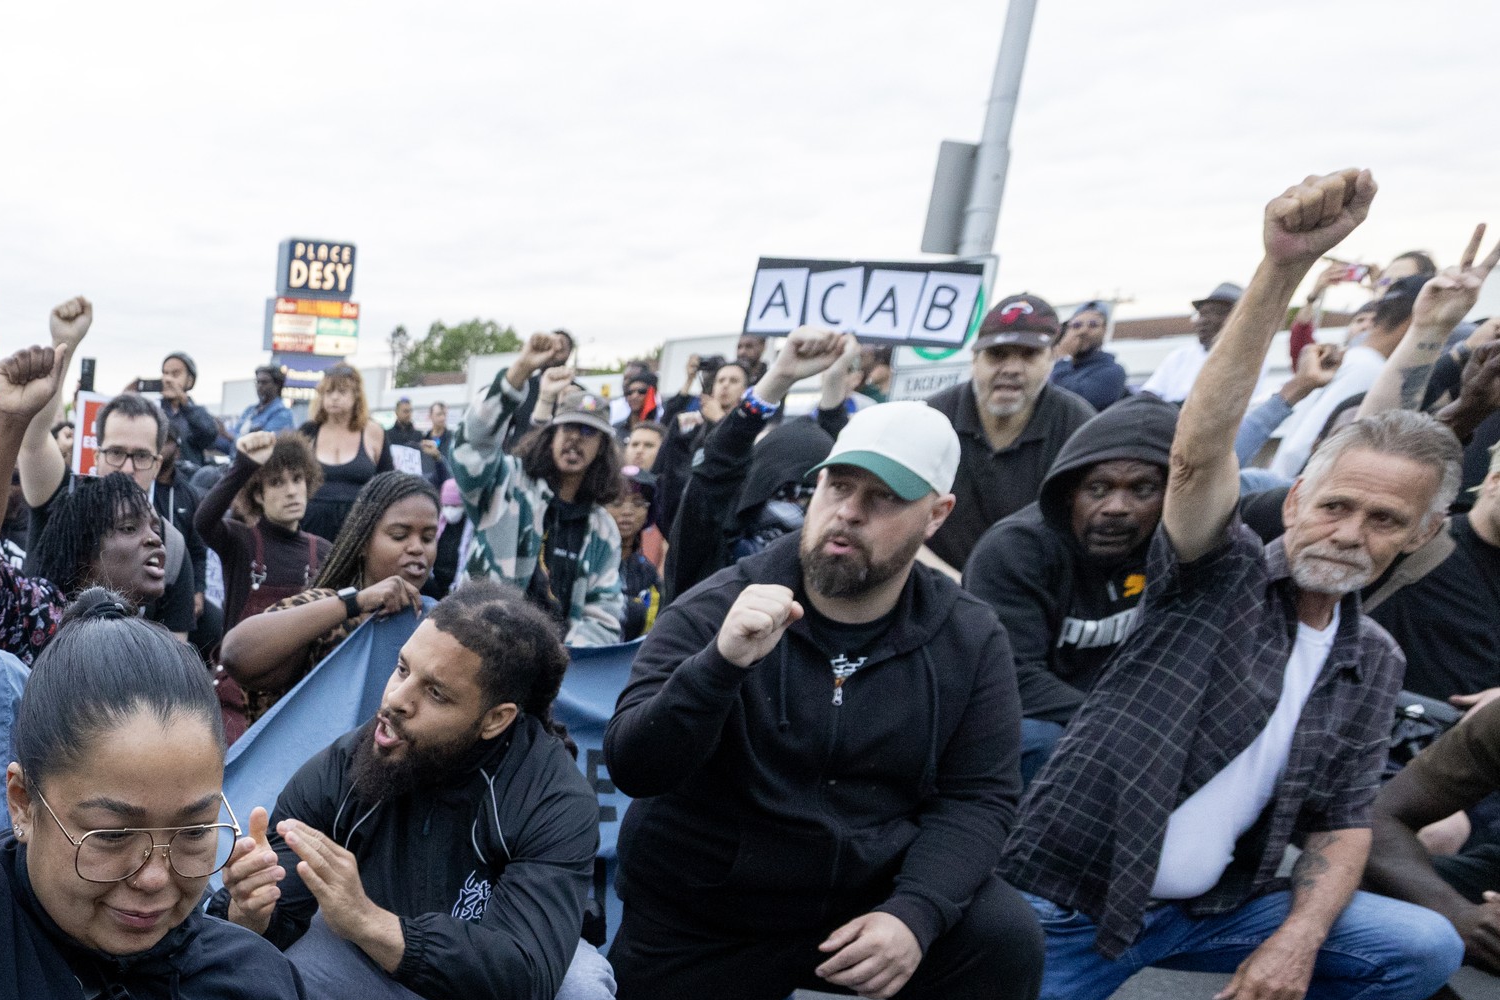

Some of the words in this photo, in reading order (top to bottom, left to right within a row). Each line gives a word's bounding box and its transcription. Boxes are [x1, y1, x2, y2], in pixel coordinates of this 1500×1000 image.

[294, 242, 351, 263] PLACE
[289, 260, 352, 292] DESY
[759, 280, 959, 332] ACAB
